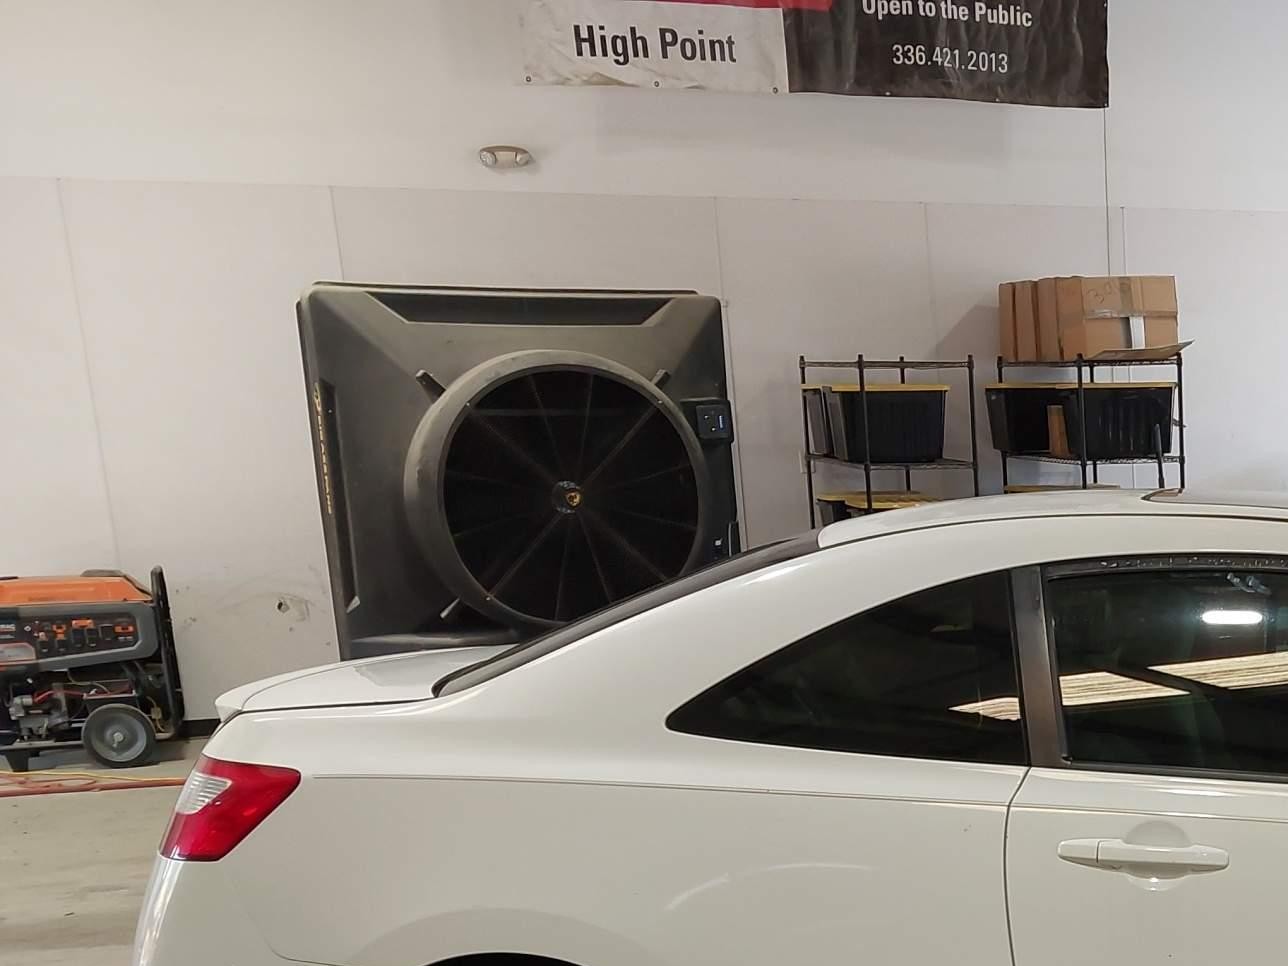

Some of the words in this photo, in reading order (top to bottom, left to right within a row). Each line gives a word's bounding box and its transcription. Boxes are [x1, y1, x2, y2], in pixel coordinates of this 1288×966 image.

[862, 0, 913, 20] Open
[918, 0, 936, 17] to
[940, 1, 969, 21] the
[975, 2, 1033, 27] Public
[572, 24, 650, 66] High
[658, 27, 737, 63] Point
[892, 44, 1008, 73] 336.421.2013
